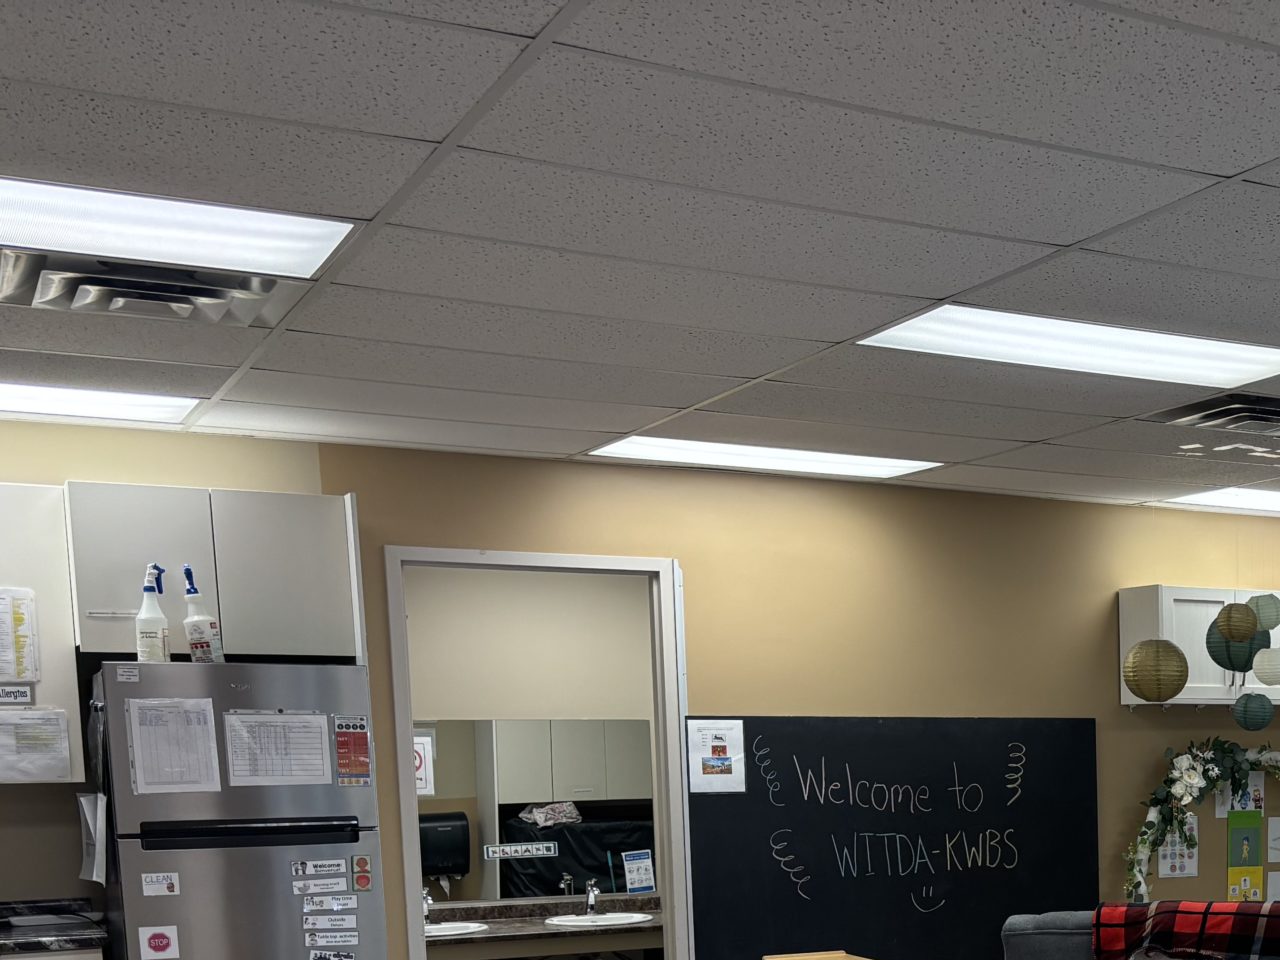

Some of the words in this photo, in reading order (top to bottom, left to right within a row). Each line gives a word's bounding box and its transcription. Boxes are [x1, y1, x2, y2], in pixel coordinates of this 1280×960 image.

[0, 688, 28, 700] llergies
[793, 754, 932, 814] Welcome
[947, 761, 984, 813] to
[144, 874, 173, 884] CLEAN
[150, 938, 169, 947] STOP
